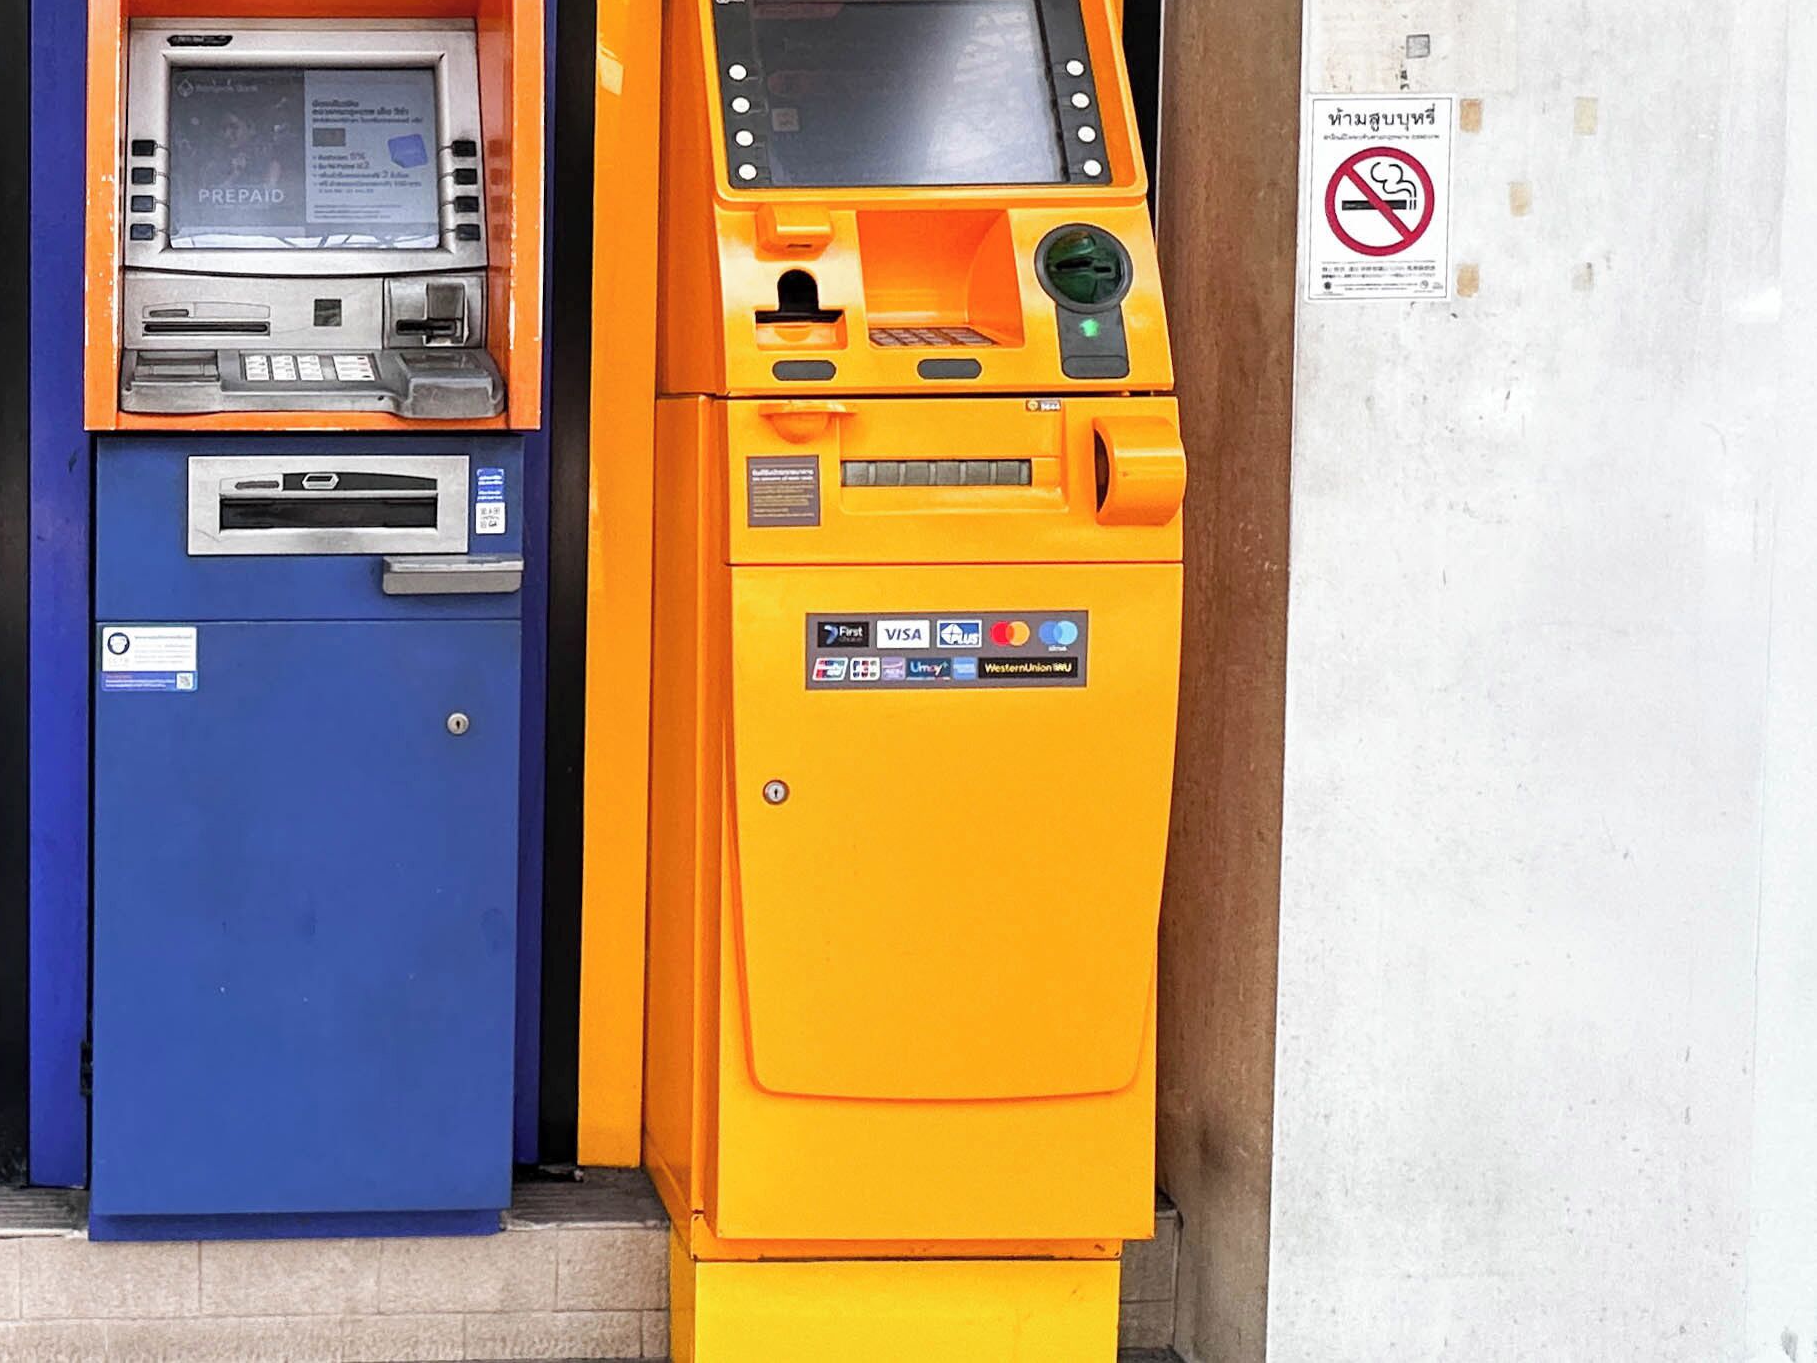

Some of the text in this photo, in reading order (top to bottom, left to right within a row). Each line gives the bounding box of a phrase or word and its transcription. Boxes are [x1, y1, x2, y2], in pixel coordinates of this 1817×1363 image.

[1328, 103, 1436, 131] ห้ามสูบบุหรี่
[198, 189, 284, 203] PREPAID
[885, 628, 922, 640] VISA
